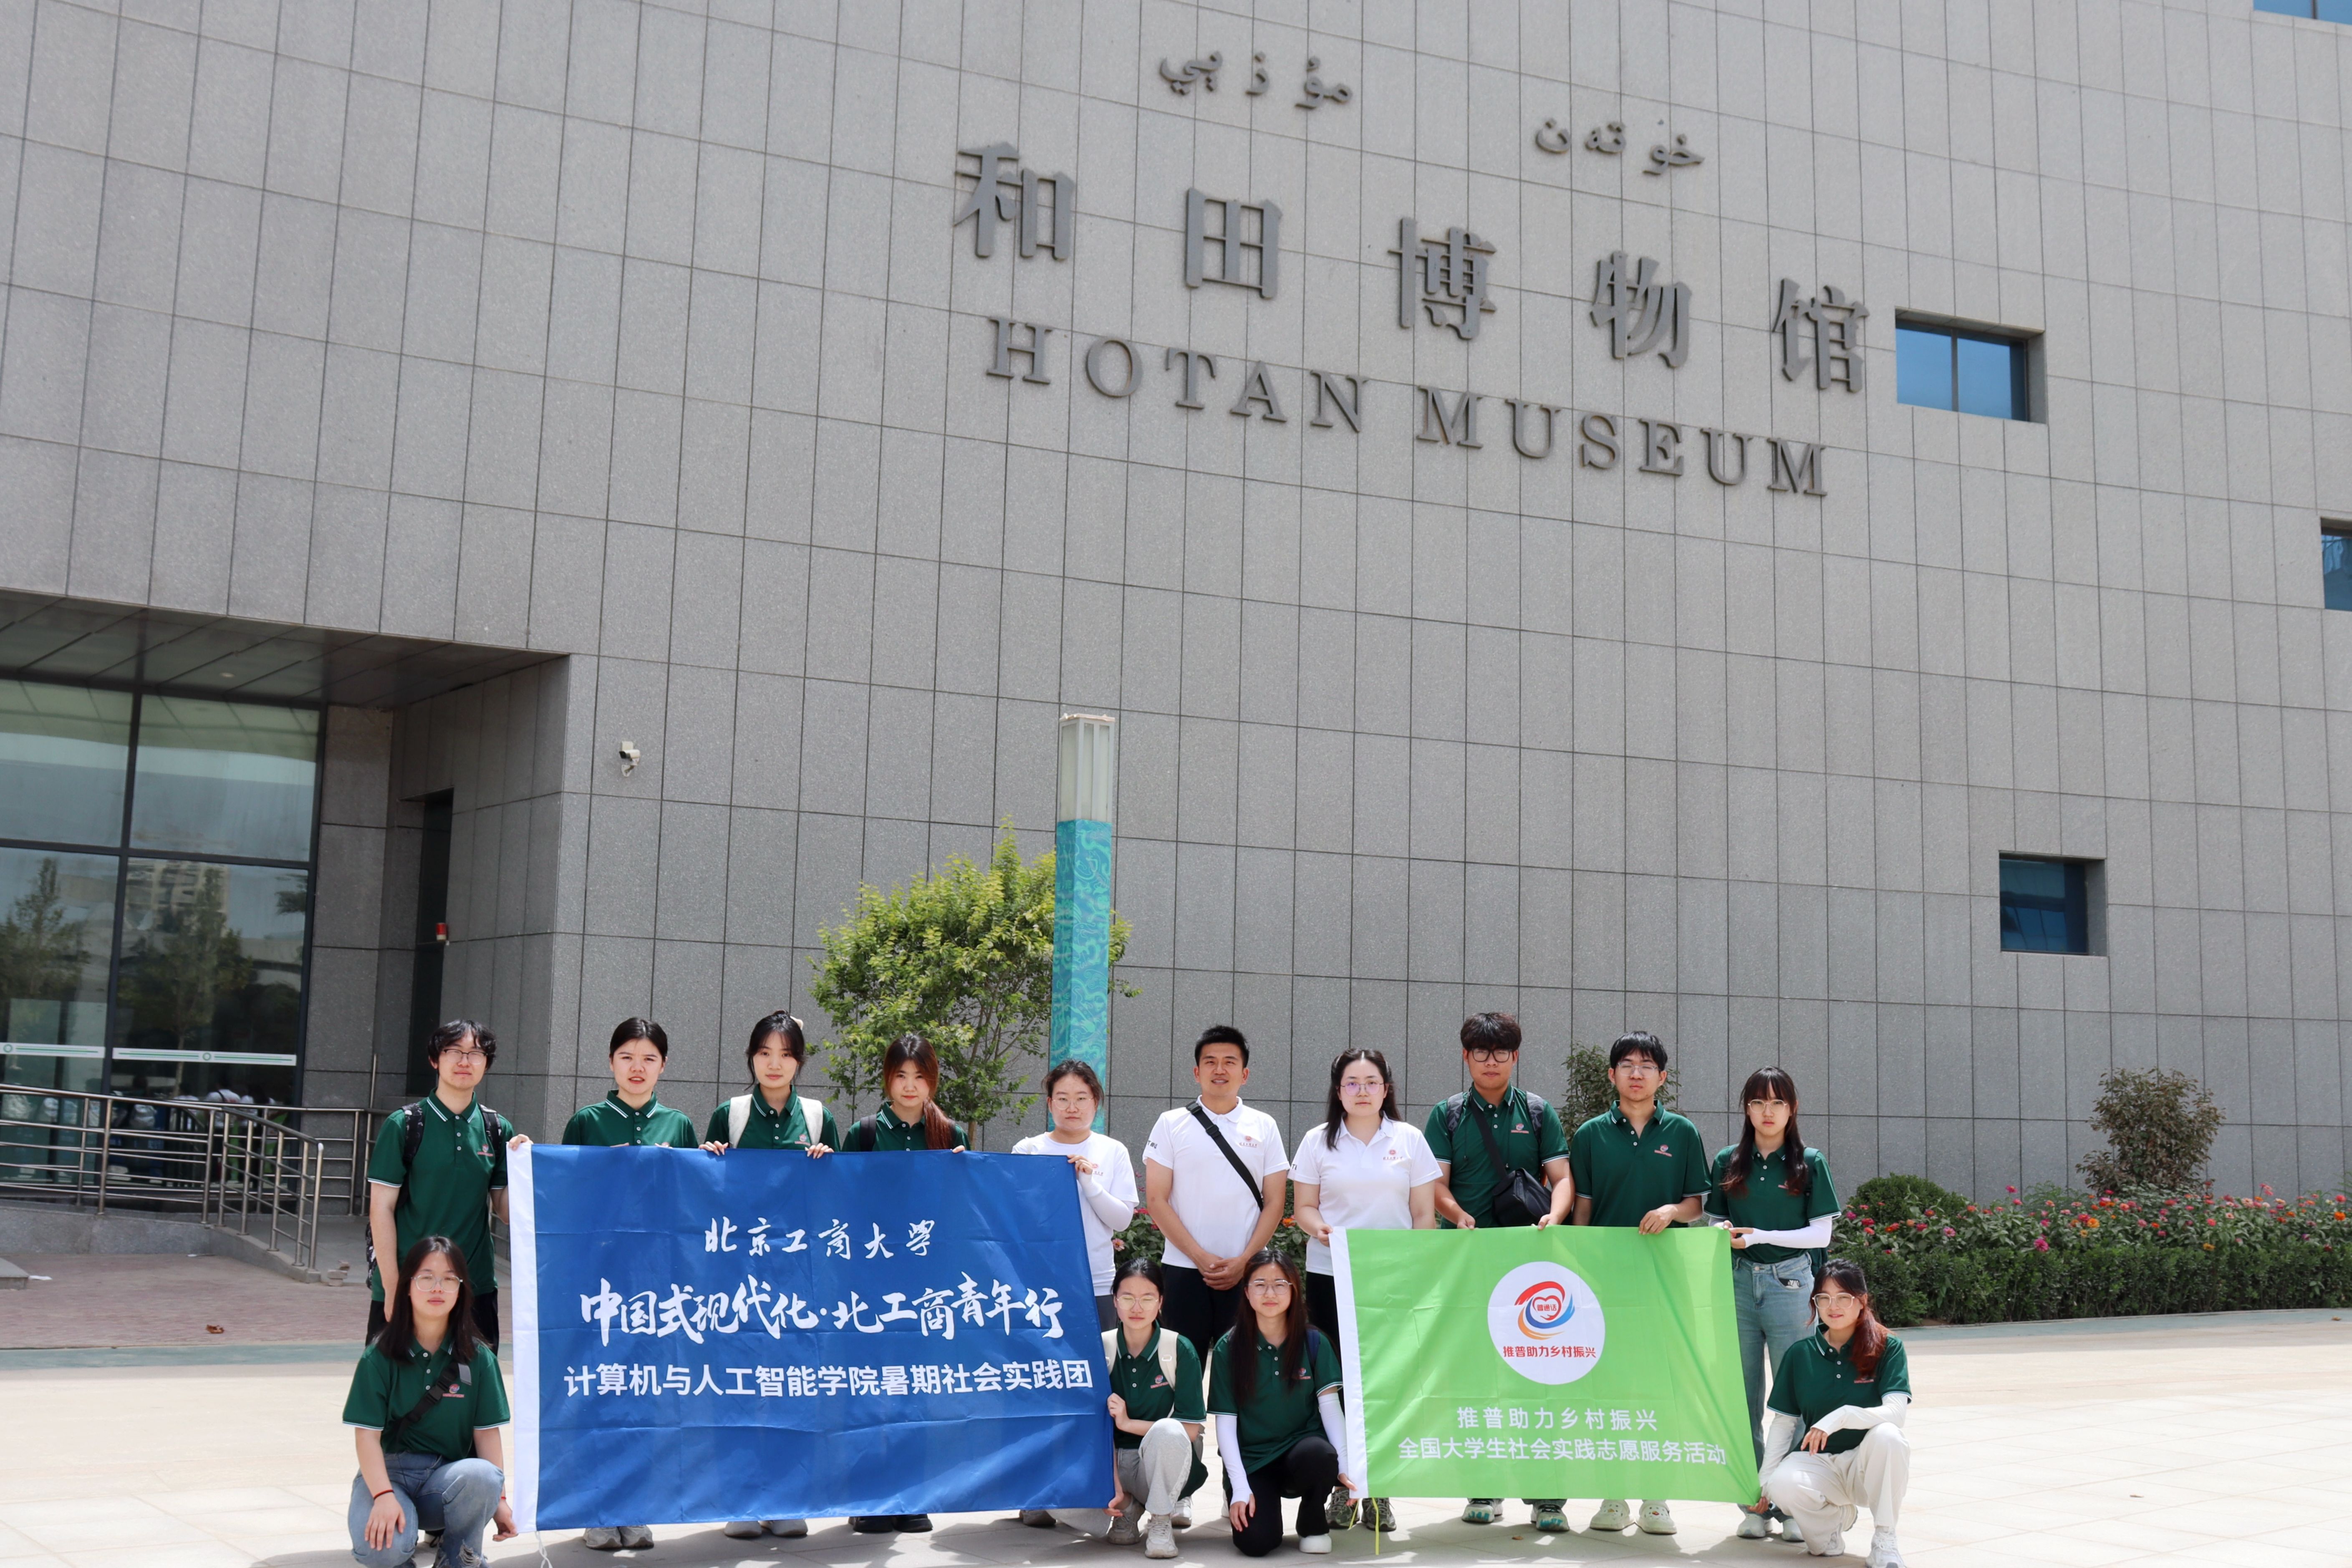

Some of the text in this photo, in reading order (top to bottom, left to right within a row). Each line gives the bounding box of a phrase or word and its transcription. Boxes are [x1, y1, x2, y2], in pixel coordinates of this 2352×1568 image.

[953, 142, 1870, 393] 和田博物馆
[986, 316, 1828, 497] HOTAN MUSEUM
[580, 1271, 1064, 1347] 中国式现代化·北工商青年行
[1503, 1345, 1596, 1359] 推普助力乡村振兴
[563, 1359, 1094, 1397] 计算机与人工智能学院暑期社会实践团
[1456, 1406, 1658, 1432] 推普助力乡村振兴
[1398, 1437, 1727, 1466] 全国大学生社会实践志愿服务活动
